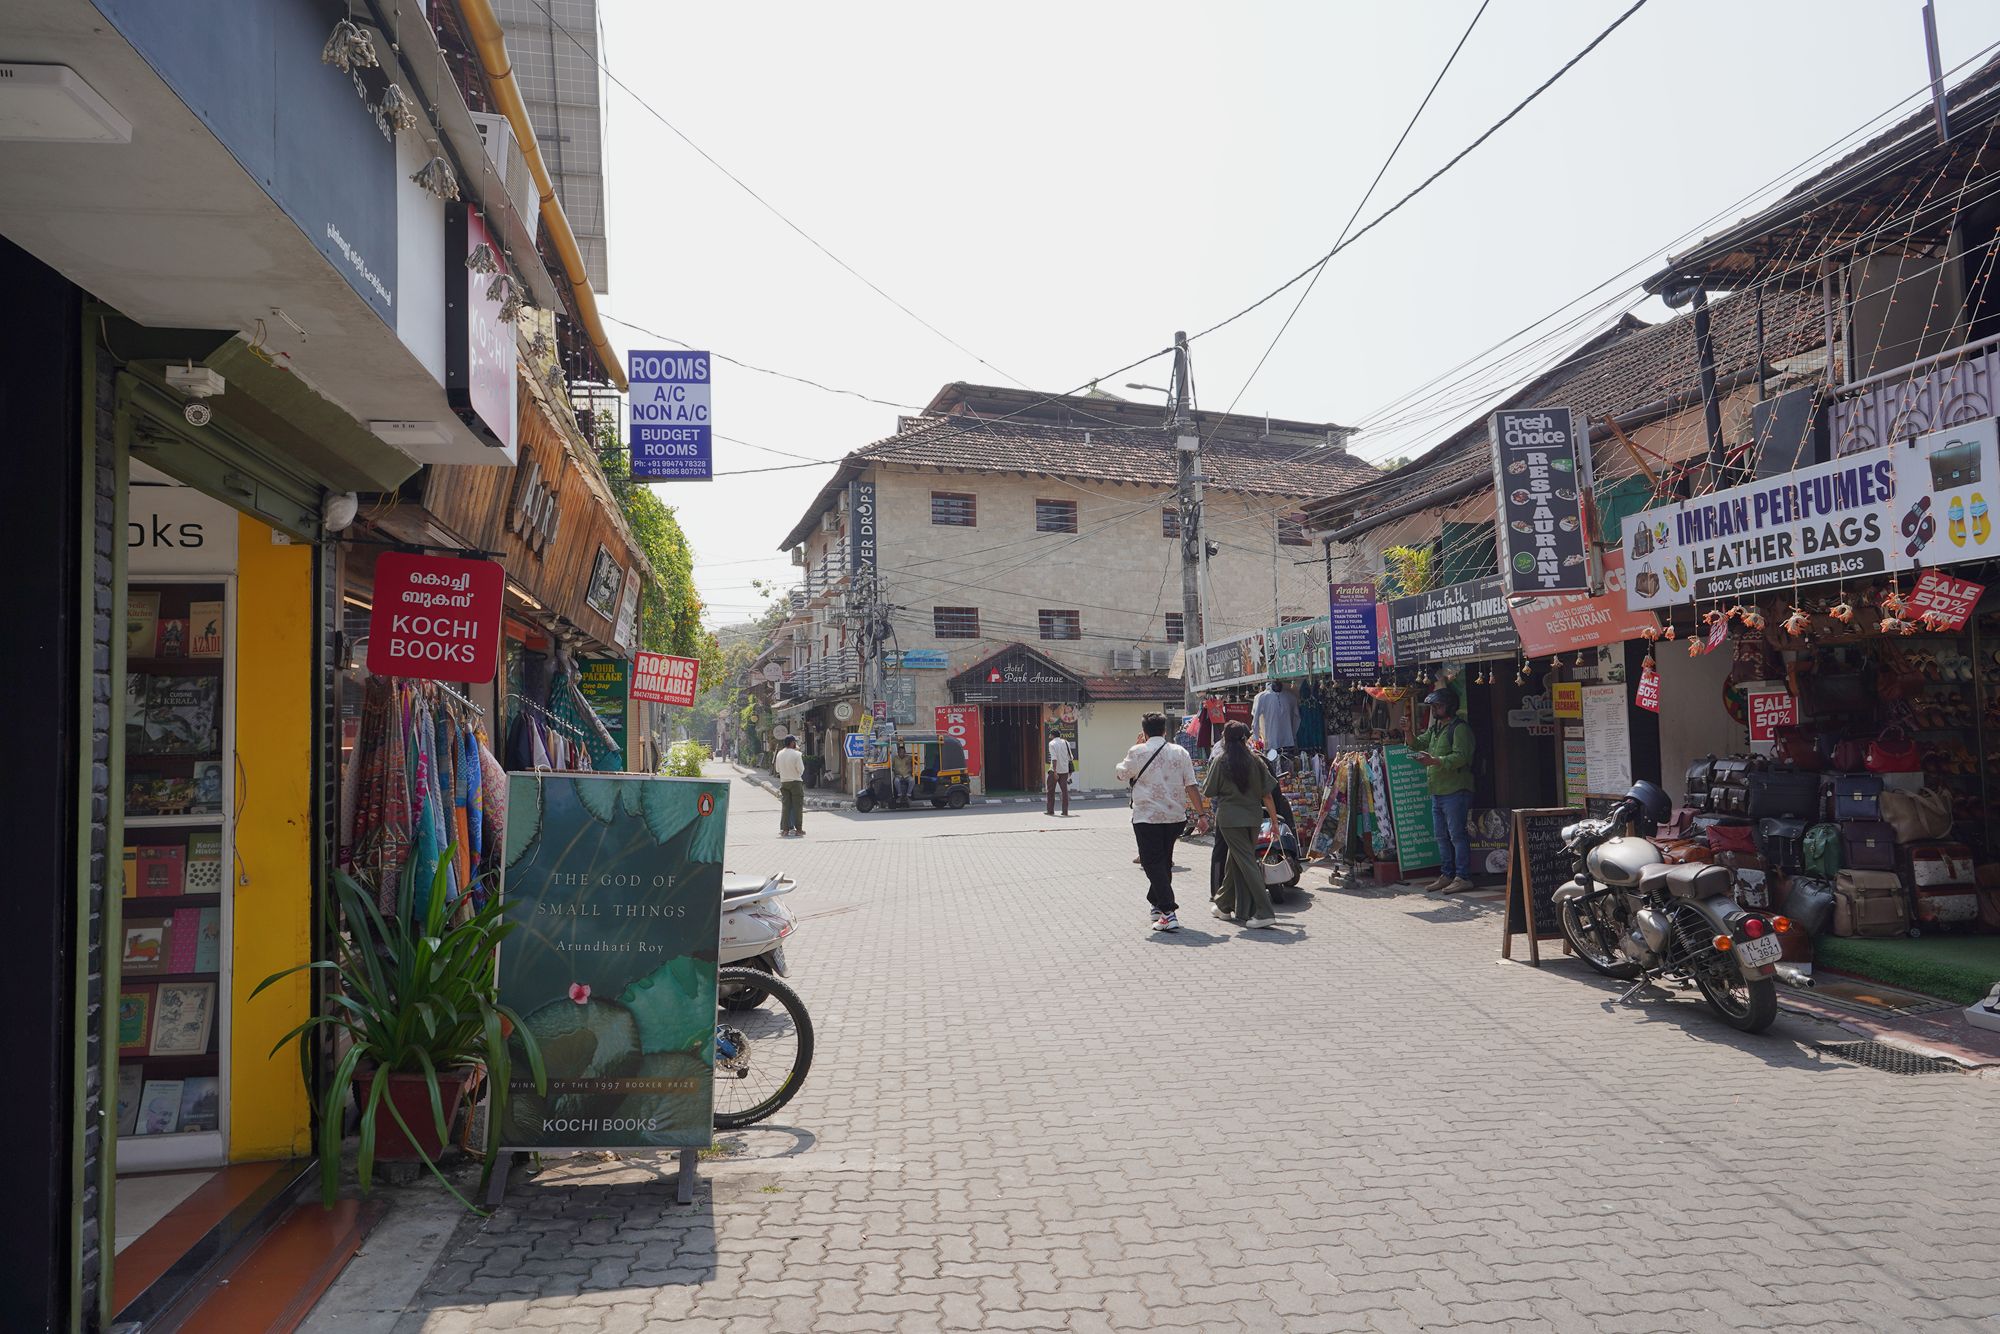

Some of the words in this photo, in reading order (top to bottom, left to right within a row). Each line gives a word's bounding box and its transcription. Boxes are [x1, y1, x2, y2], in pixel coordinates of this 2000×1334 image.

[471, 303, 507, 374] KOCHI
[631, 357, 708, 380] ROOMS
[653, 385, 685, 403] A/C
[633, 404, 672, 421] NON
[676, 403, 708, 421] A/C
[1504, 413, 1553, 431] Fresh
[641, 429, 701, 441] BUDGET
[1504, 429, 1566, 446] Choice
[645, 444, 698, 456] ROOMS
[856, 486, 873, 535] DROPS
[1676, 499, 1750, 547] IMRAN
[1753, 459, 1897, 530] PERFUMES
[1526, 452, 1560, 588] RESTAURANT
[128, 513, 204, 548] oks
[1692, 531, 1793, 575] LEATHER
[1801, 512, 1882, 555] BAGS
[410, 572, 470, 592] കൊച്ചി
[1707, 577, 1733, 594] 100%
[1733, 569, 1782, 589] GENUINE
[1783, 564, 1829, 584] LEATHER
[1830, 557, 1865, 575] BAGS
[1335, 586, 1370, 595] Arafath
[1919, 575, 1980, 601] SALE
[1425, 587, 1469, 611] Arafath
[1914, 591, 1970, 615] 50%
[1396, 616, 1412, 634] RENT
[1412, 614, 1419, 631] A
[1419, 610, 1438, 629] BIKE
[1438, 605, 1462, 626] TOURS
[1463, 606, 1471, 621] &
[1471, 596, 1508, 619] TRAVELS
[1545, 608, 1613, 634] RESTAURANT
[392, 614, 478, 640] KOCHI
[192, 636, 221, 653] AZADI
[1281, 629, 1302, 651] GIFT
[390, 638, 475, 663] BOOKS
[591, 663, 616, 673] TOUR
[637, 655, 695, 680] ROOMS
[1003, 663, 1025, 673] Hotel
[582, 672, 623, 682] PACKAGE
[633, 673, 693, 696] AVAILABLE
[1004, 672, 1028, 683] Park
[1029, 672, 1064, 683] Avenue
[1639, 674, 1659, 688] SALE
[1558, 690, 1576, 700] MONEY
[1638, 685, 1658, 700] 50%
[1554, 701, 1580, 712] EXCHANGE
[1641, 698, 1658, 709] OFF
[1753, 695, 1793, 714] SALE
[1756, 711, 1791, 727] 50%
[1528, 725, 1555, 736] TICK
[551, 873, 589, 885] THE
[601, 874, 641, 887] GOD
[652, 875, 677, 887] OF
[537, 903, 601, 916] SMALL
[613, 904, 686, 918] THINGS
[556, 940, 630, 951] Arundhati
[638, 941, 665, 954] Roy
[1745, 941, 1759, 952] KL
[1760, 936, 1771, 947] 43
[1757, 944, 1780, 958] 3621
[595, 1081, 621, 1091] 1997
[542, 1118, 598, 1132] KOCHI
[602, 1118, 658, 1132] BOOKS
